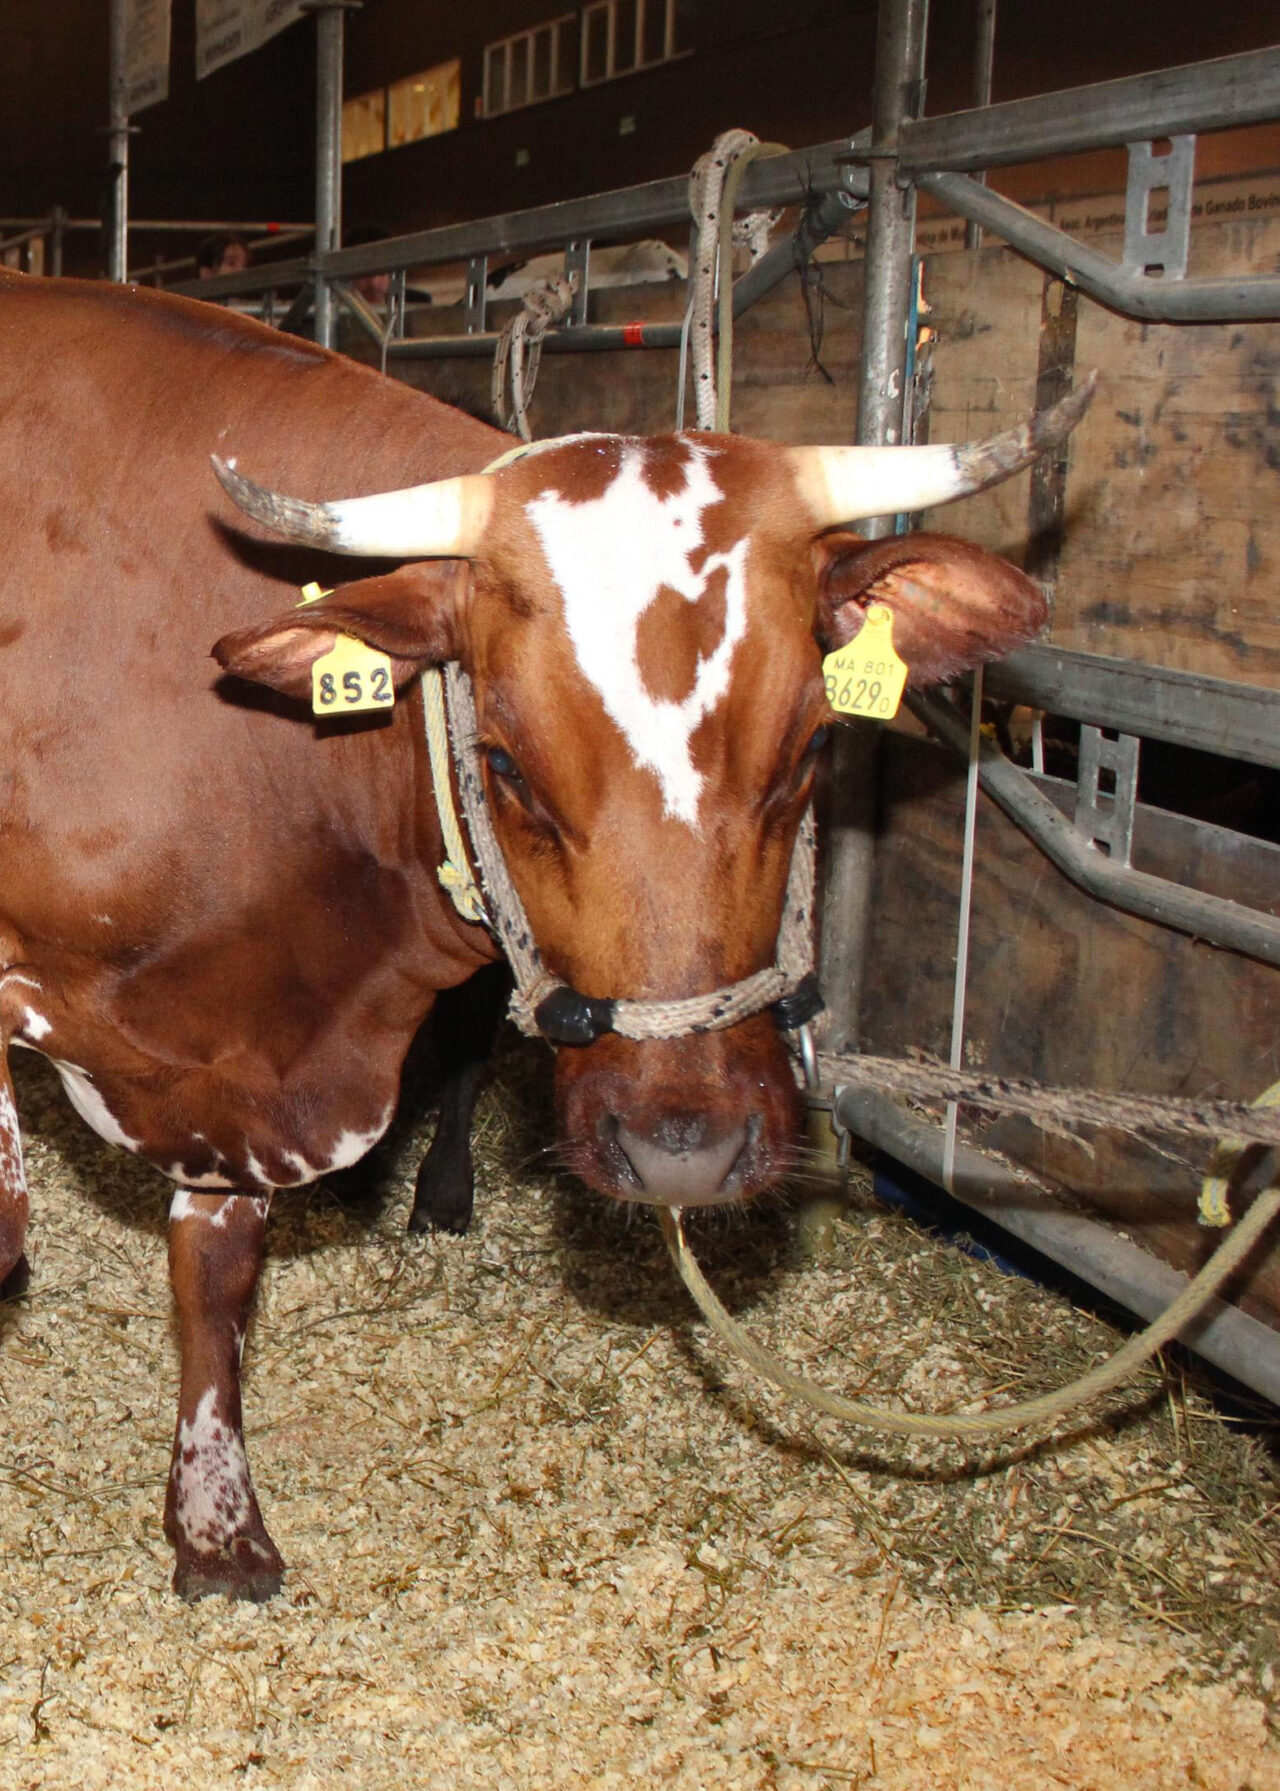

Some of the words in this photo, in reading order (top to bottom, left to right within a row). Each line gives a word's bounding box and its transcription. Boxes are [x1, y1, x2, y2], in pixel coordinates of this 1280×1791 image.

[1205, 198, 1245, 216] Ganado
[833, 657, 856, 671] MA
[864, 661, 895, 676] 801
[319, 666, 392, 705] 852
